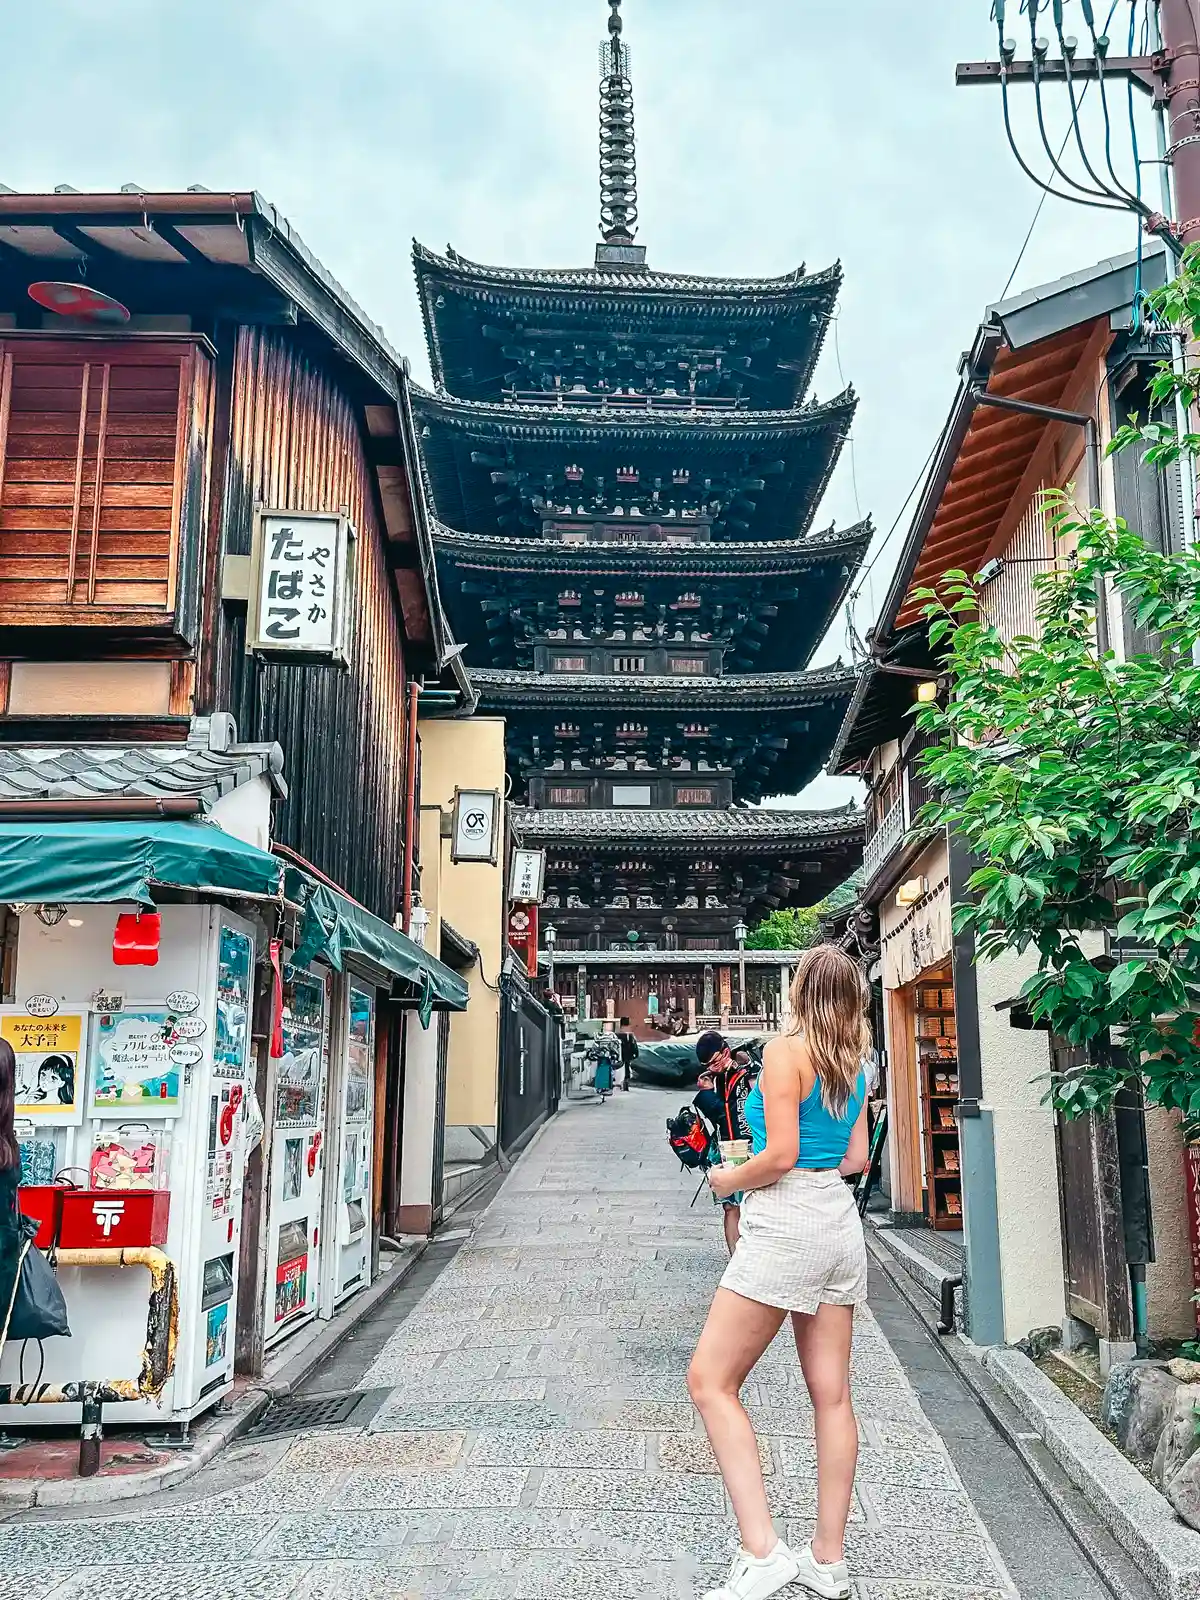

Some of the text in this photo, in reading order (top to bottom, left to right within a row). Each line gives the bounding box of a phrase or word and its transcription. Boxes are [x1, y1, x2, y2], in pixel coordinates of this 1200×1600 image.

[265, 527, 304, 639] たばこ
[307, 546, 330, 624] やさか
[466, 813, 484, 828] OR
[13, 1023, 67, 1032] あなたの未来を
[20, 1033, 59, 1047] 大予言
